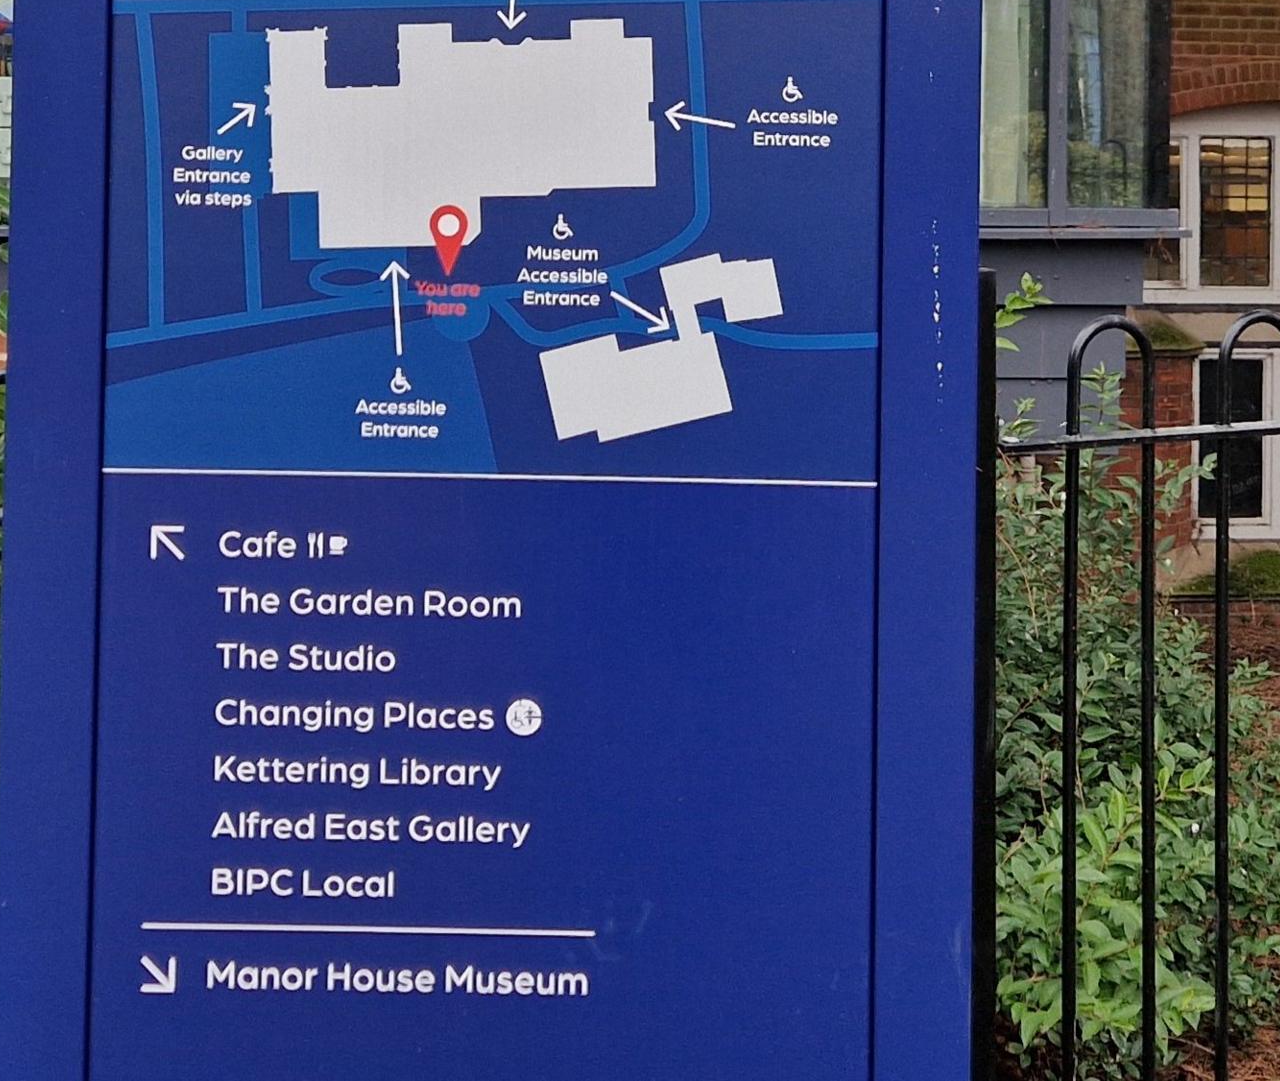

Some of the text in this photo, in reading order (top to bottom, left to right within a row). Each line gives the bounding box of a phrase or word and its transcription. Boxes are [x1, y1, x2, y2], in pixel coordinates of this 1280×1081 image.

[747, 109, 838, 124] Accessible
[754, 132, 830, 147] Entrance
[182, 146, 243, 162] Gallery
[174, 168, 250, 183] Entrance
[175, 190, 251, 208] via steps
[527, 246, 598, 260] Museum
[518, 268, 607, 283] Accessible
[415, 281, 480, 297] You are
[524, 291, 600, 306] Entrance
[427, 300, 466, 316] here
[356, 399, 446, 415] Accessible
[362, 422, 438, 438] Entrance
[219, 531, 296, 558] Cafe
[218, 587, 521, 617] The Garden Room
[216, 643, 395, 671] The Studio
[216, 699, 494, 732] Changing Places
[215, 756, 501, 790] Kettering Library
[212, 811, 530, 848] Alfred East Gallery
[212, 868, 394, 897] BIPC Local
[207, 961, 588, 995] Manor House Museum
